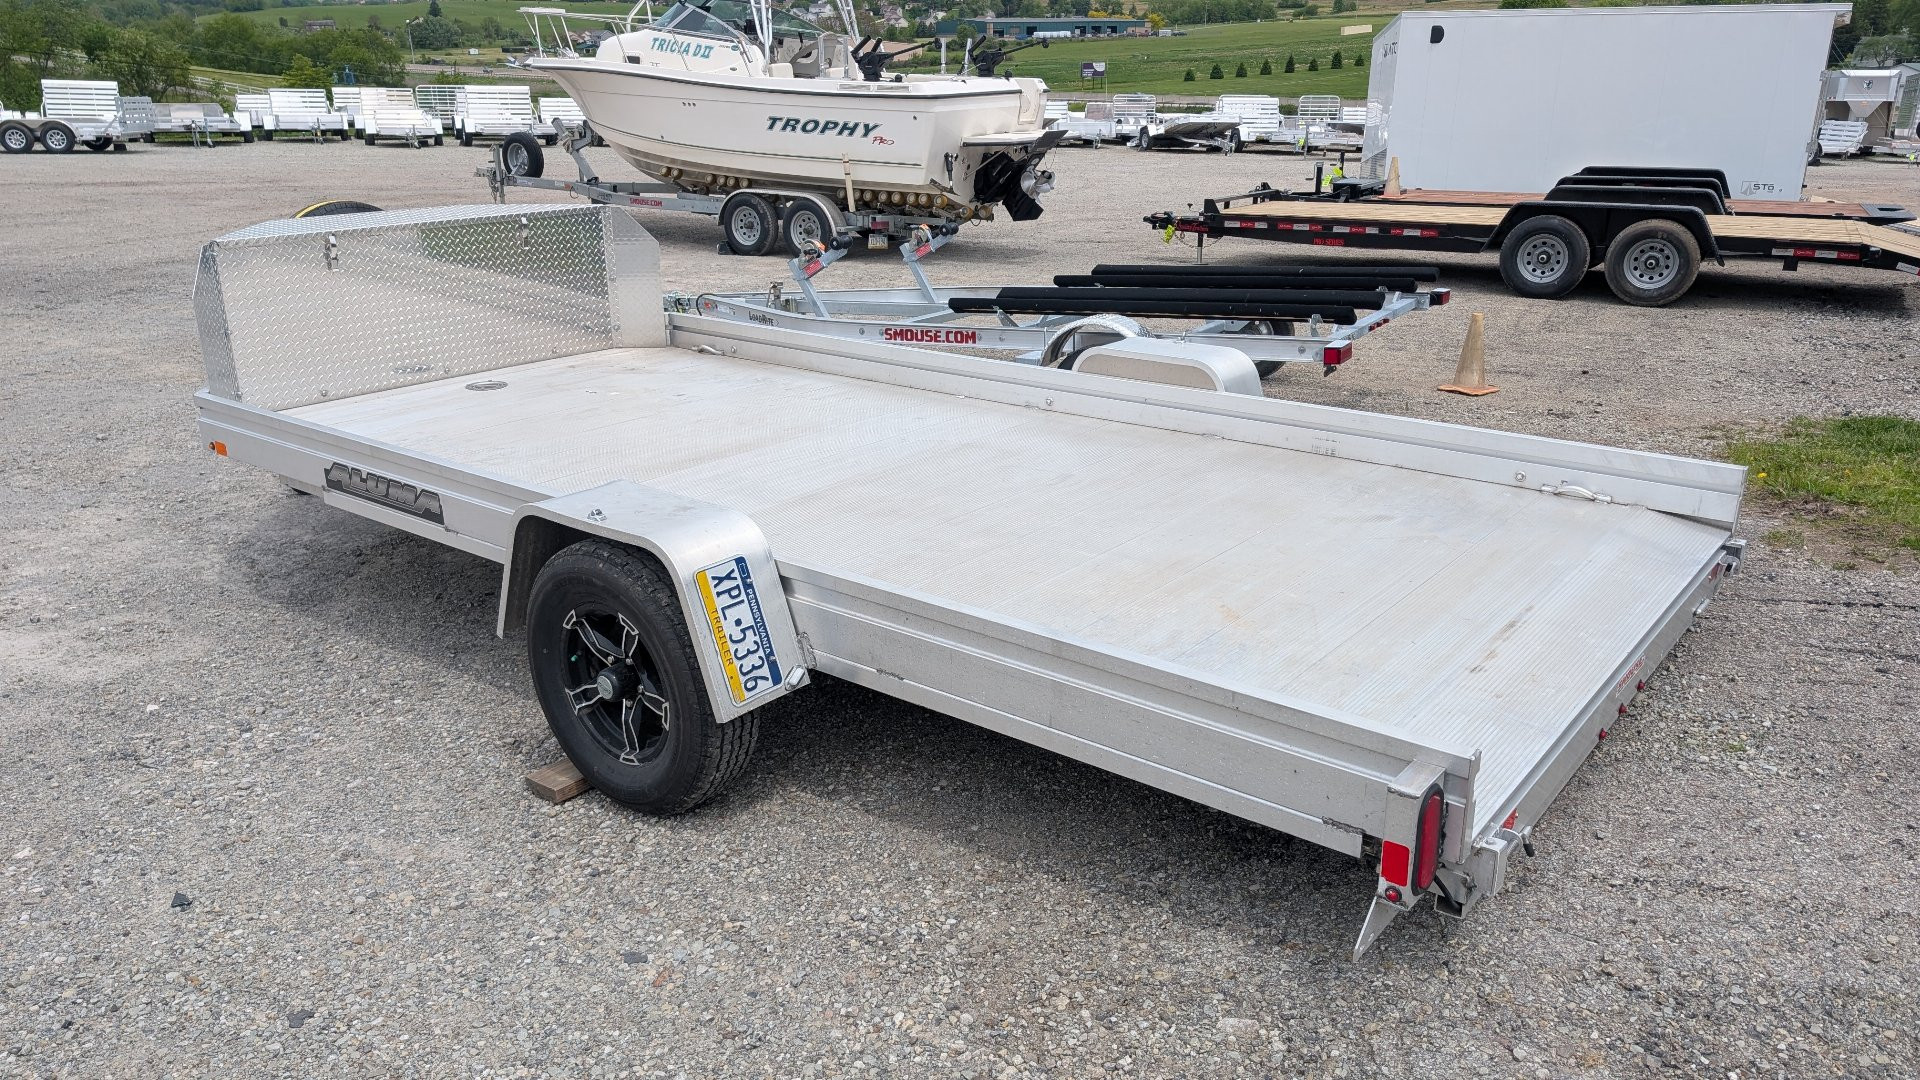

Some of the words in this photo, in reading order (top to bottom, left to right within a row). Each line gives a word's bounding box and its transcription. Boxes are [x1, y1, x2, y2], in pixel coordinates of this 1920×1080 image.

[650, 36, 691, 56] TRICIA
[766, 115, 883, 139] TROPHY
[629, 197, 663, 208] SMOUSE.COM
[884, 327, 977, 344] SMOUSE.COM
[326, 461, 442, 518] ALUMA
[746, 588, 771, 656] PENNSYLVANIA
[710, 608, 734, 667] TRAILER
